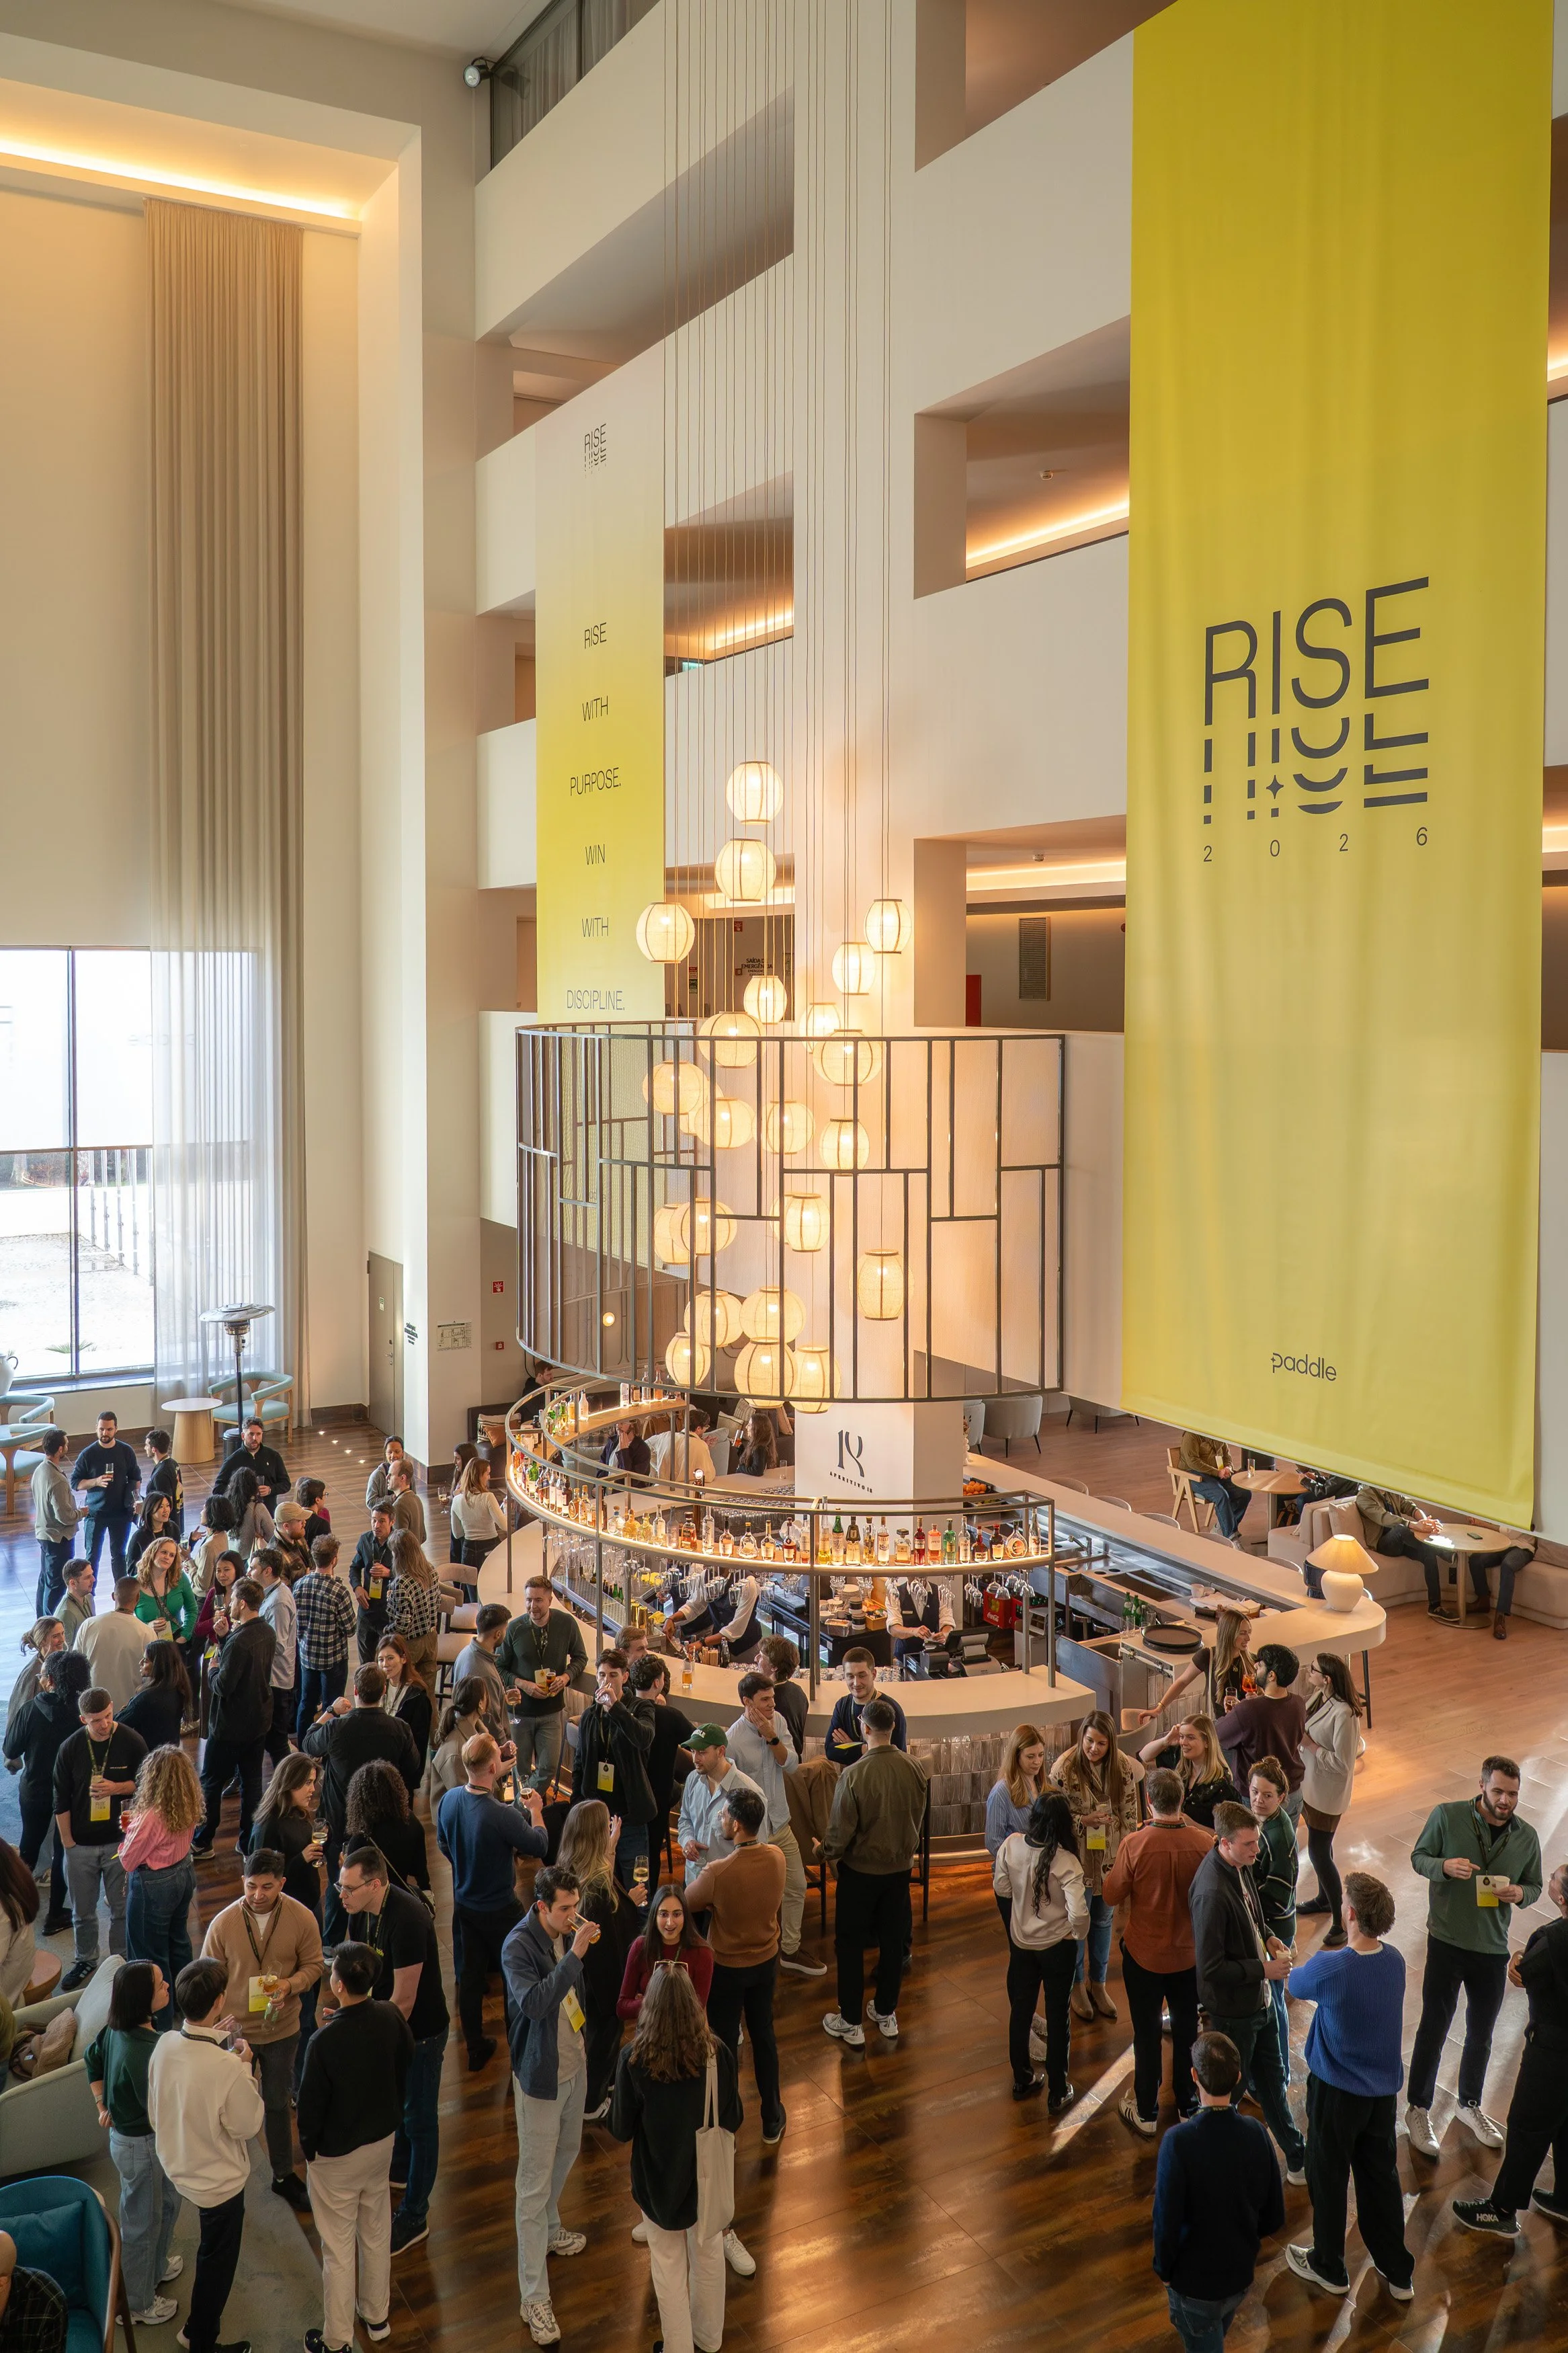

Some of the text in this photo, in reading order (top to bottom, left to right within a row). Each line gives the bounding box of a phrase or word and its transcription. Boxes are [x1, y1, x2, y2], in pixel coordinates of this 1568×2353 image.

[584, 423, 606, 454] RISE
[584, 622, 607, 649] RISE
[1204, 576, 1430, 727] RISE
[582, 696, 608, 722] WITH
[570, 767, 621, 796] PURPOSE.
[585, 844, 606, 865] WIN
[581, 917, 609, 938] WITH
[567, 990, 625, 1010] DISCIPLINE.
[1270, 1352, 1337, 1382] paddle
[829, 1471, 866, 1490] APERITIVO
[1476, 2213, 1499, 2223] HOKA
